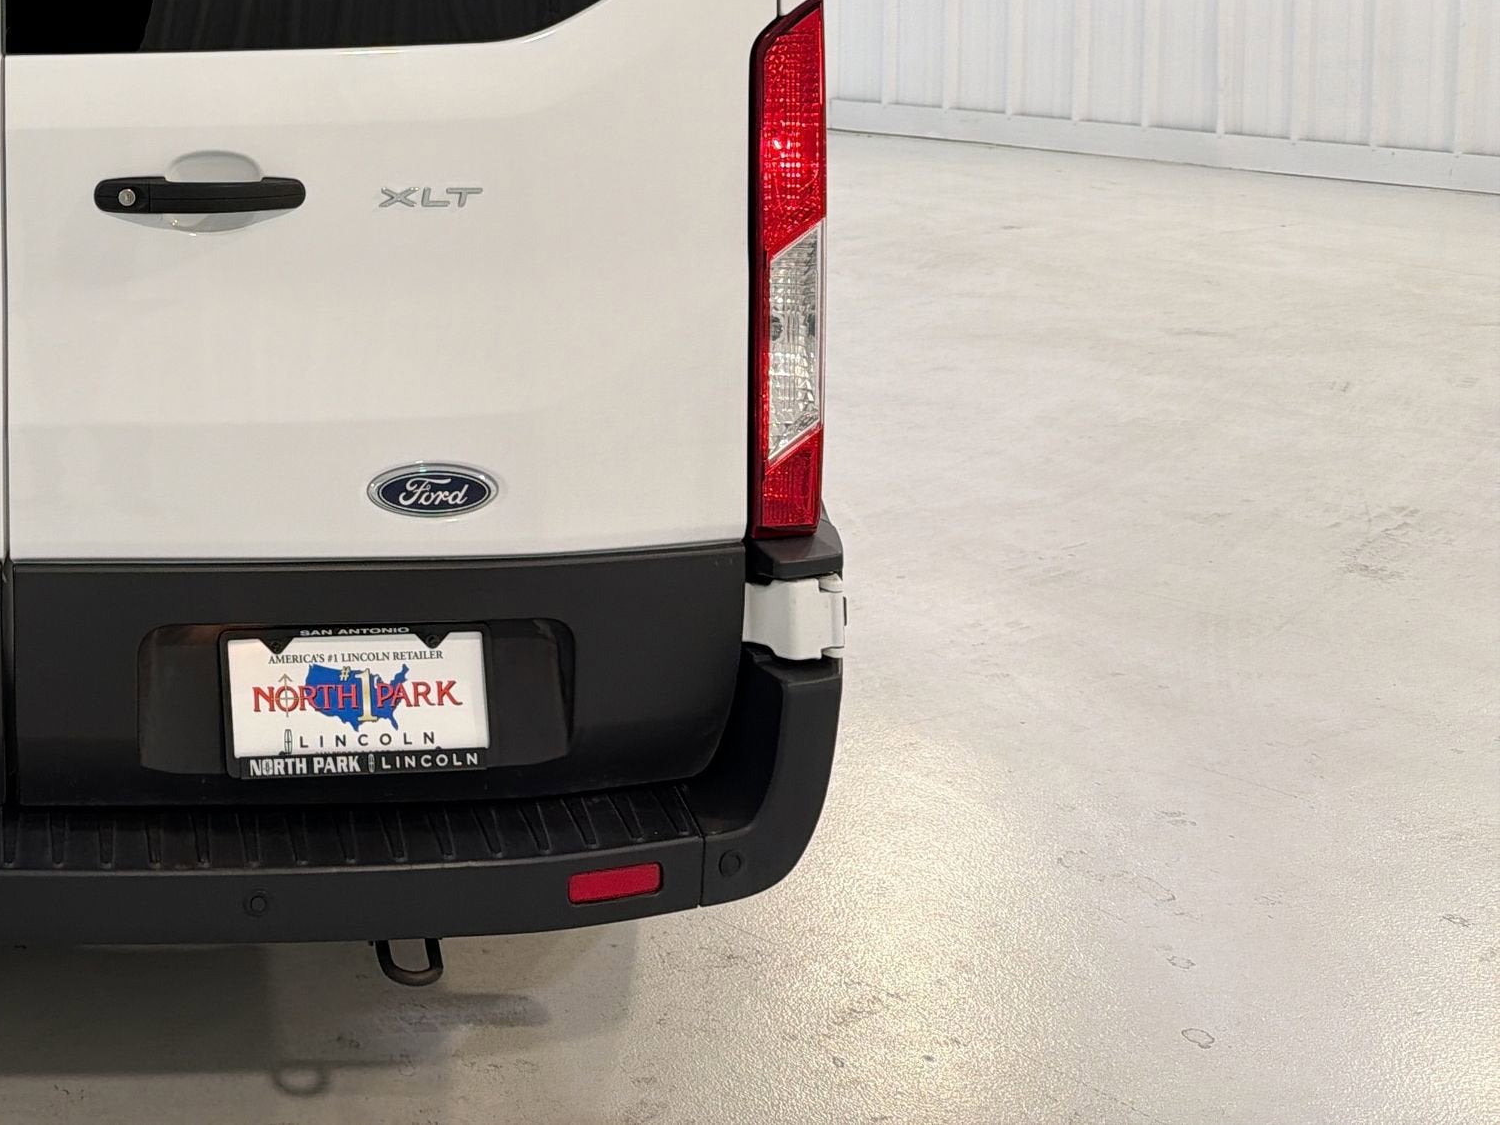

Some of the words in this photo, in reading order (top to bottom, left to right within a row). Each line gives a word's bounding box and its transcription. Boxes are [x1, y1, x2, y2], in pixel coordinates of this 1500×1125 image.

[378, 187, 483, 208] XLT
[399, 477, 468, 506] Ford
[300, 629, 332, 637] SAN
[337, 627, 409, 636] ANTONIO
[268, 653, 325, 664] AMERICA'S
[327, 653, 338, 663] #1
[341, 651, 390, 662] LINCOLN
[393, 650, 443, 661] RETAILER
[252, 683, 359, 713] NORTH
[376, 680, 463, 709] PARK
[299, 731, 435, 748] LINCOLN
[249, 757, 307, 776] NORTH
[313, 755, 361, 774] PARK
[381, 752, 478, 769] LINCOLN
